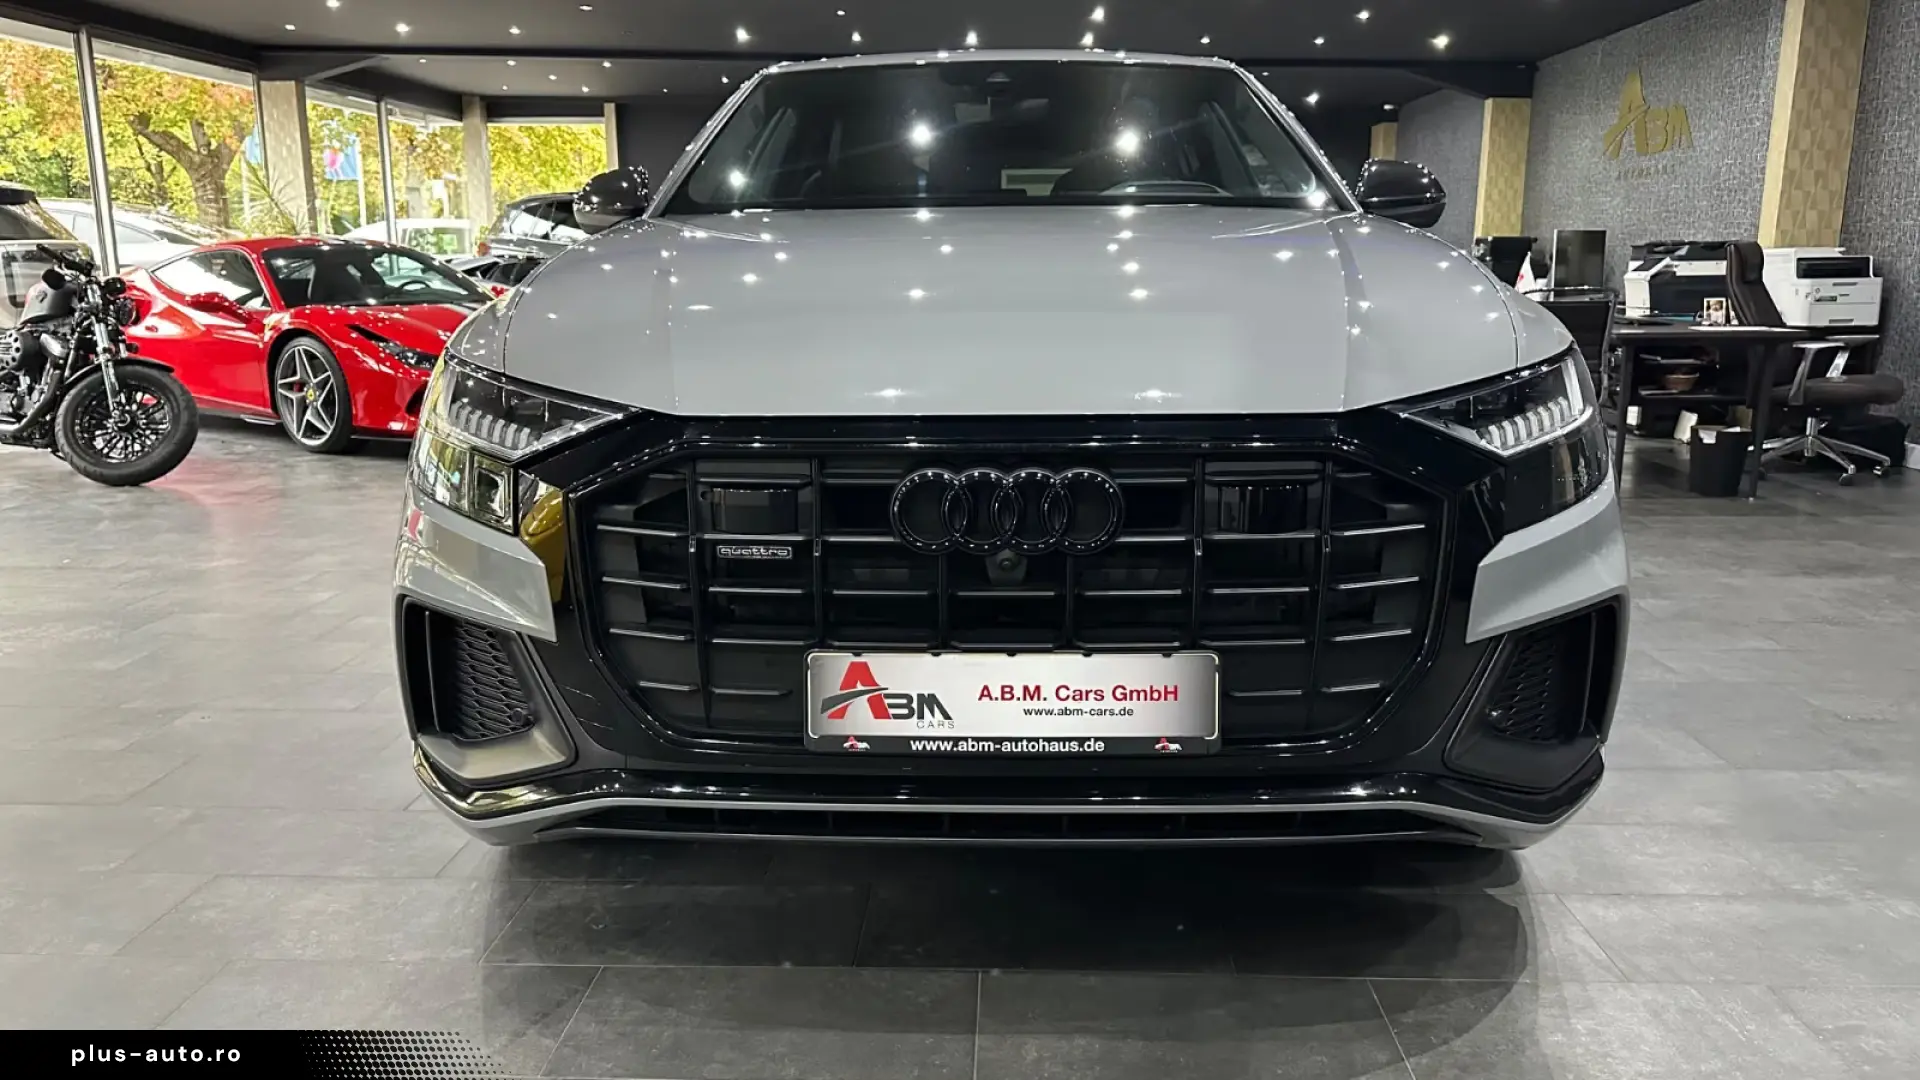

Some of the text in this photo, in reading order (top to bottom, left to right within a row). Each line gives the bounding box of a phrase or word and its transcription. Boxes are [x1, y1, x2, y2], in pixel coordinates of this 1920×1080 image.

[720, 546, 788, 557] quattro
[820, 661, 953, 720] ABM
[978, 685, 1179, 702] A.B.M. Cars GmbH
[1023, 706, 1134, 717] www.abm-cars.de
[916, 720, 955, 729] CARS
[910, 737, 1105, 752] www.abm-autohaus.de
